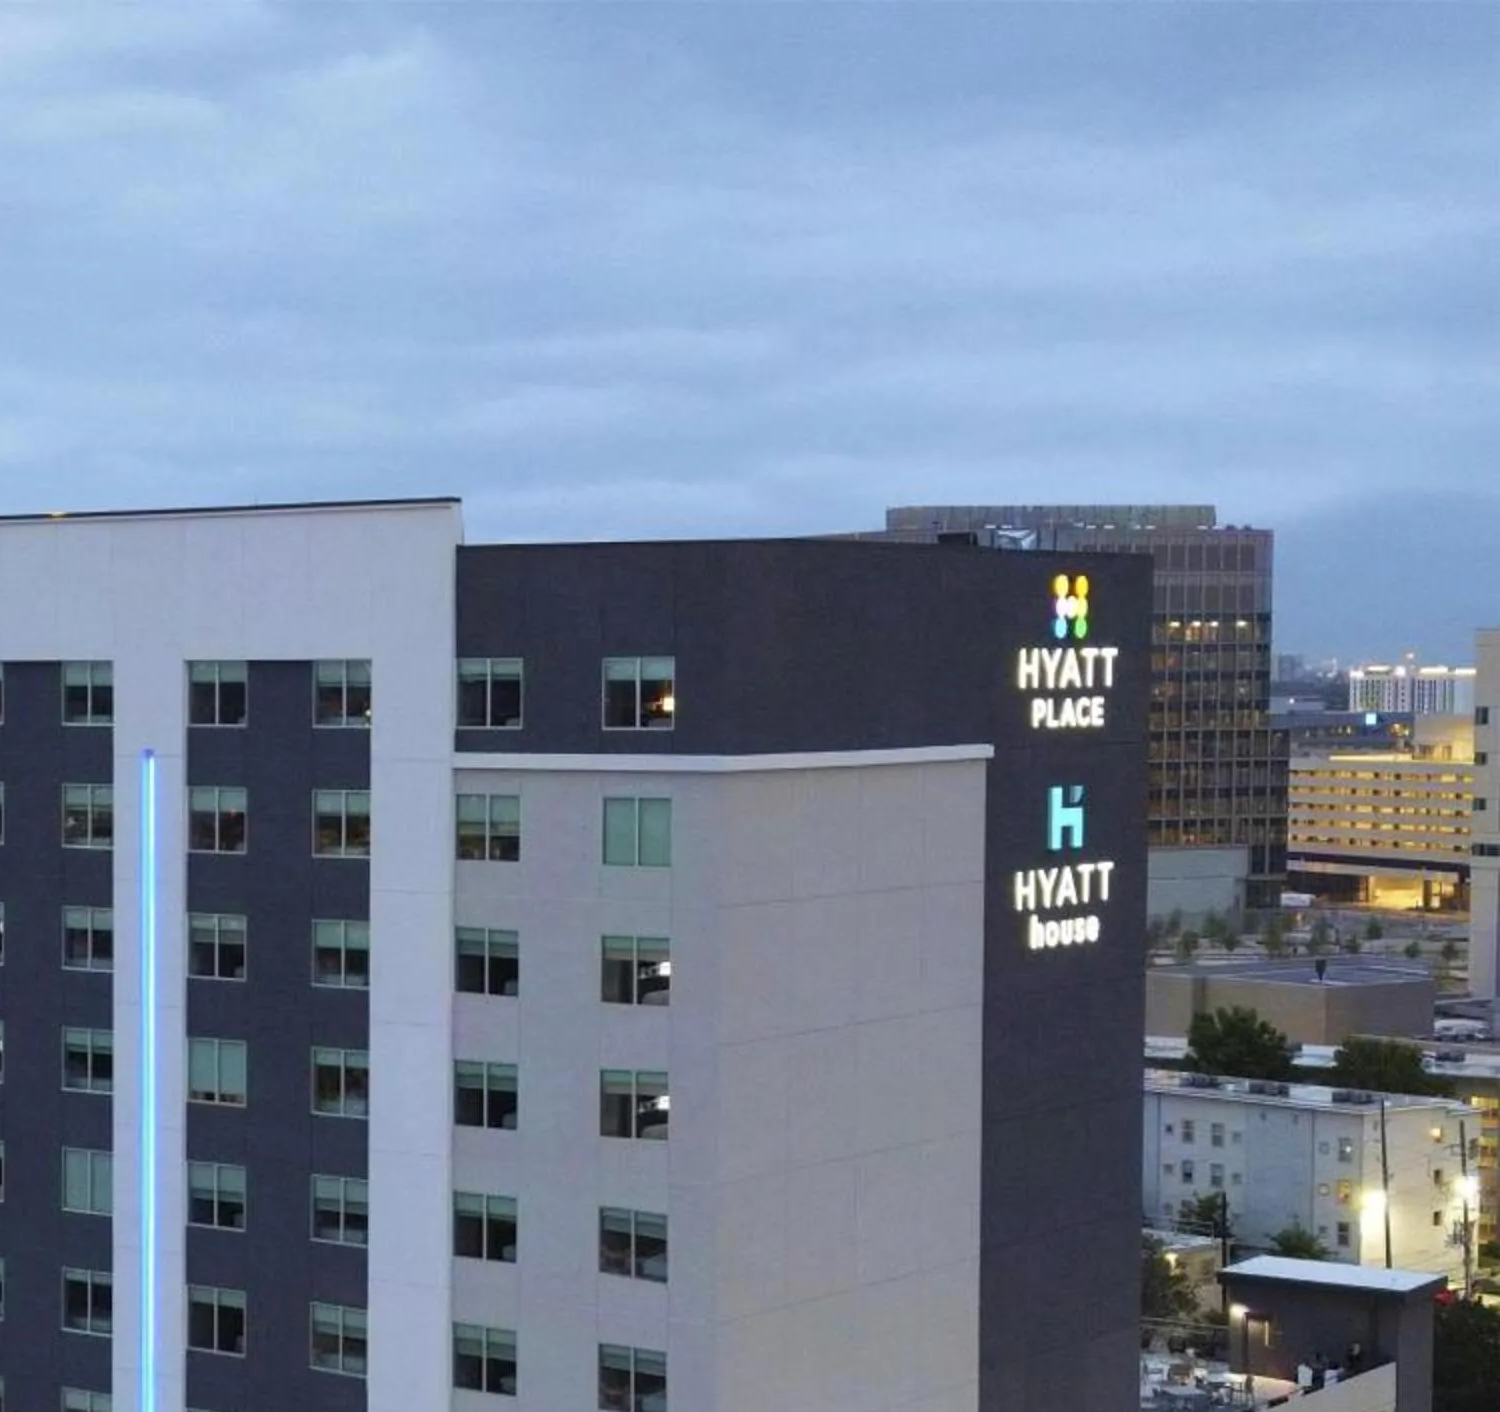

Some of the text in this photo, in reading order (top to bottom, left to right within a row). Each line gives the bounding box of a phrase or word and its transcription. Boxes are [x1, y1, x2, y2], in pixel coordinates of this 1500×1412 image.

[1017, 647, 1119, 690] HYATT
[1031, 696, 1105, 729] PLACE
[1014, 861, 1114, 911] HYATT
[1028, 914, 1100, 949] house
